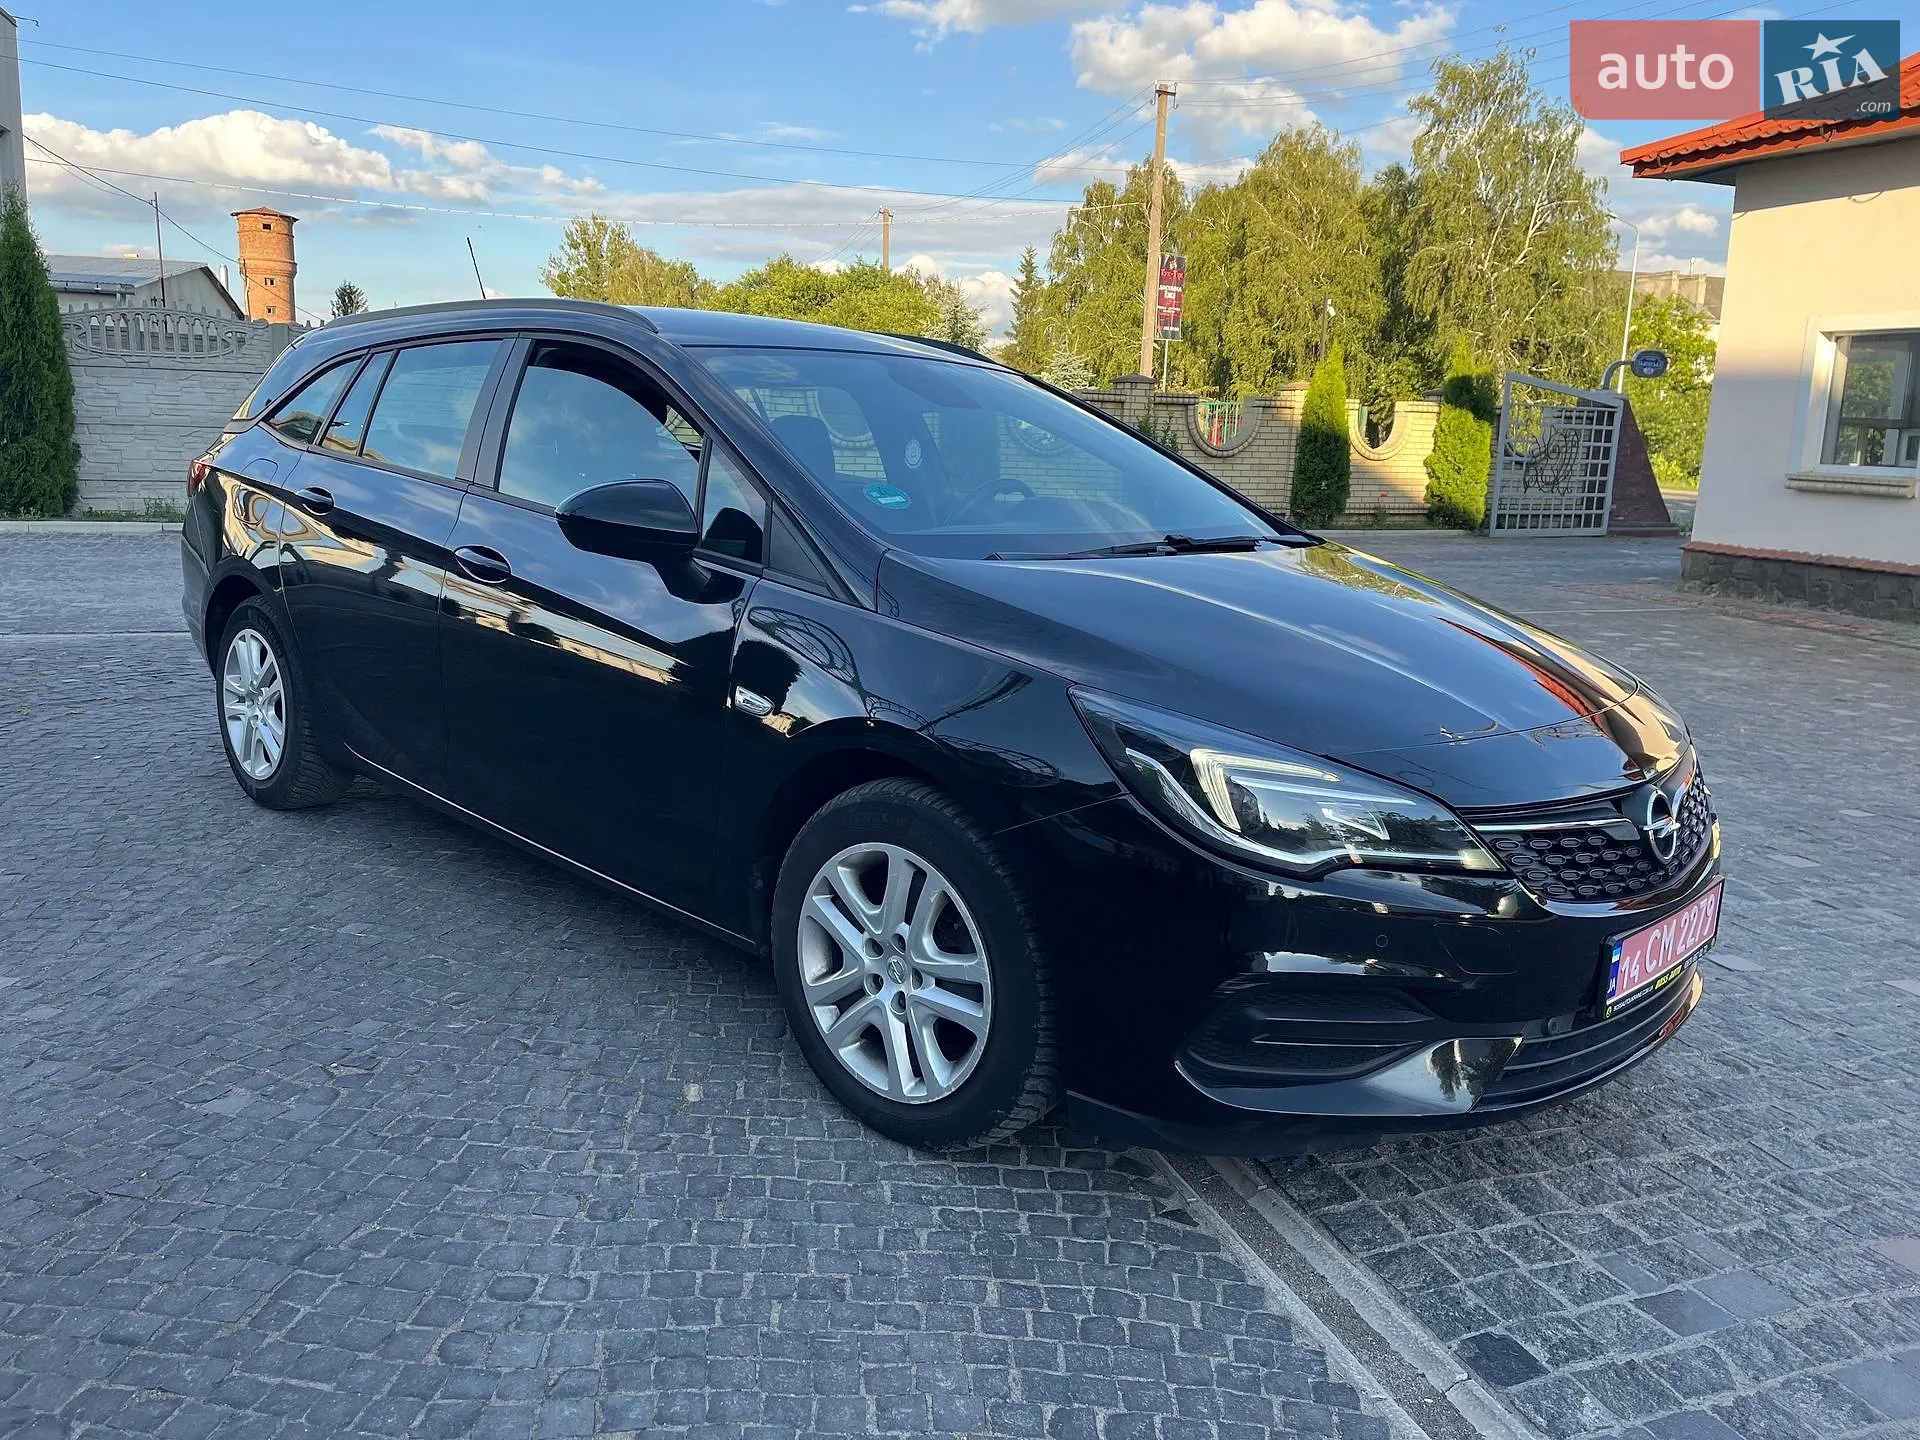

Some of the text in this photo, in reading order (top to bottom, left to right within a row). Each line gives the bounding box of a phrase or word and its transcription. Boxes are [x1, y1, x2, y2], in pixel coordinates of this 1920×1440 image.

[1621, 949, 1641, 989] 14
[1645, 919, 1677, 973] CM
[1677, 893, 1715, 955] 2279
